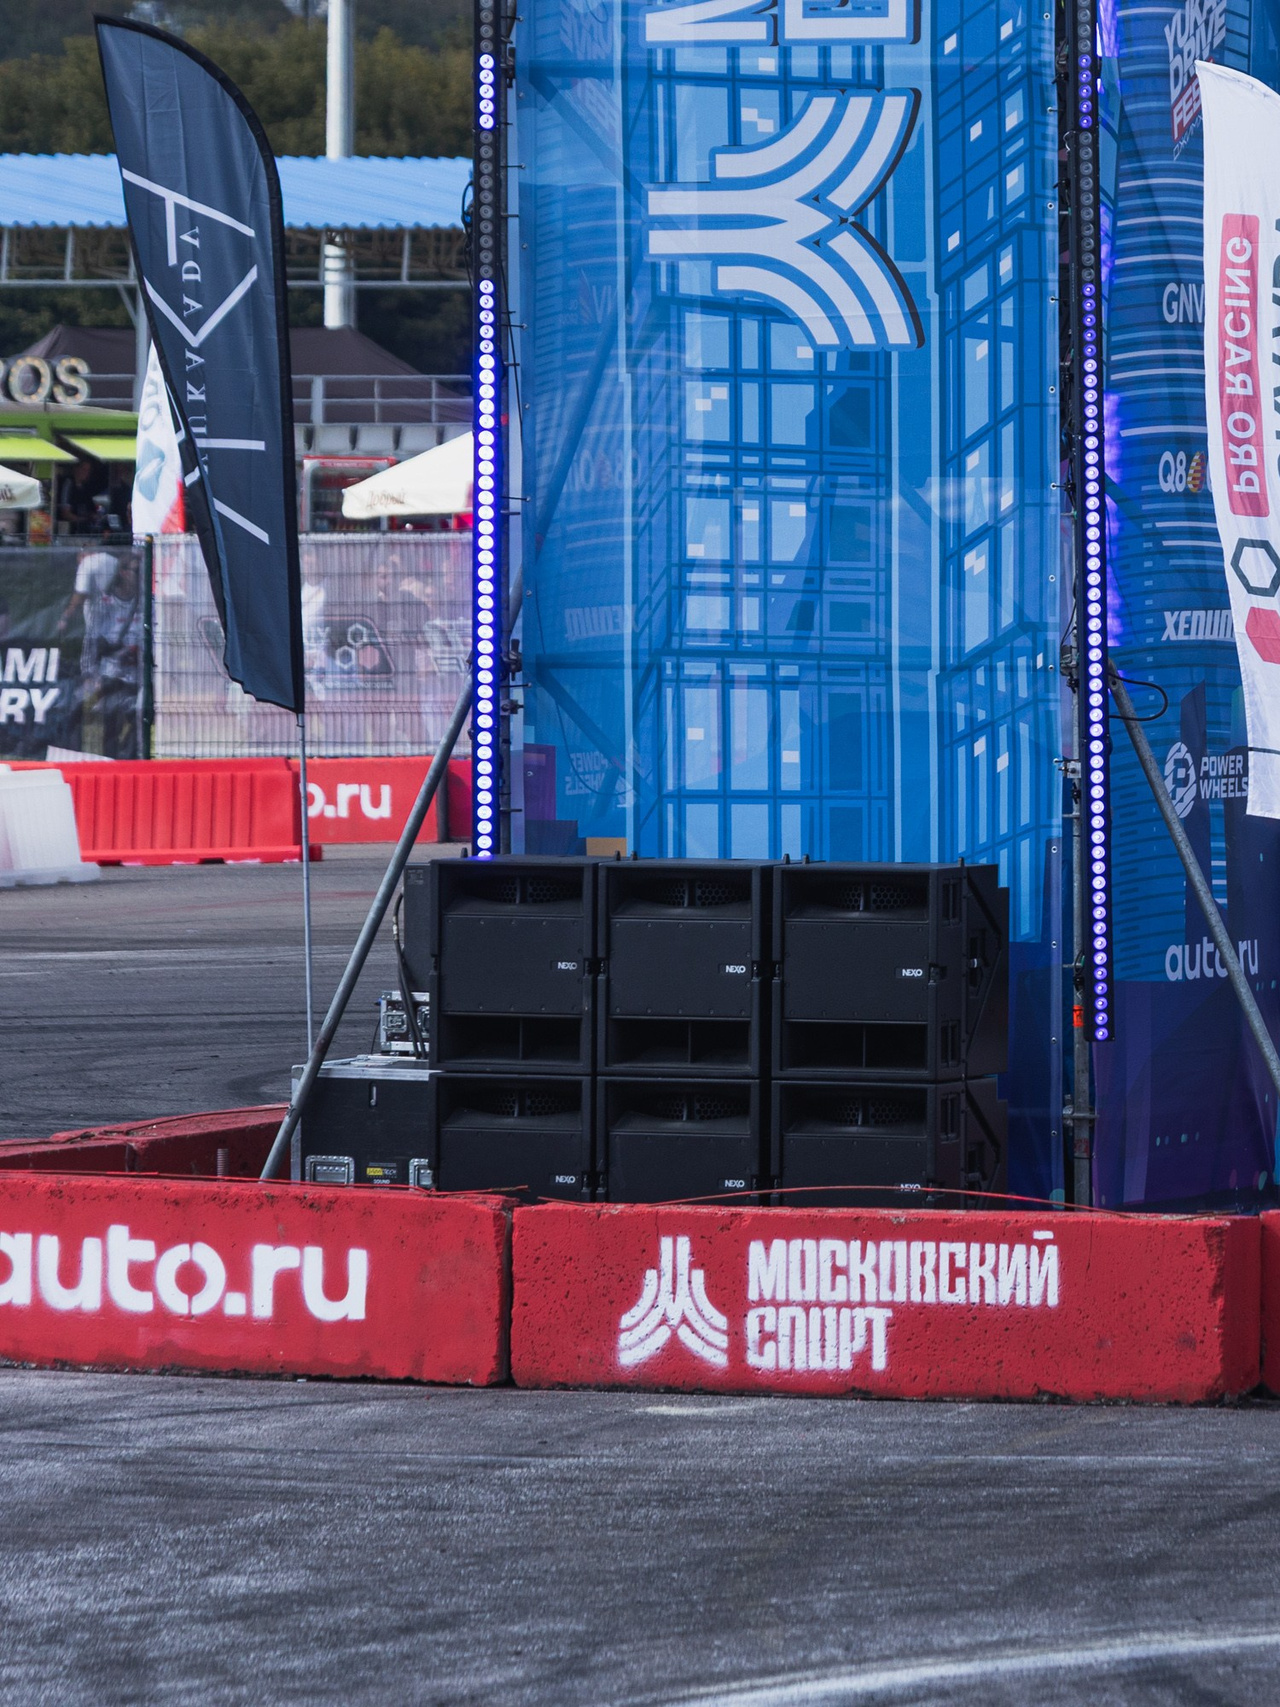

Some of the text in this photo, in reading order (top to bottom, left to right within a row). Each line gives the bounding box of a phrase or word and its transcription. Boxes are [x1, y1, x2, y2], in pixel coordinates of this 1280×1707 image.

[0, 356, 89, 403] OS
[1158, 450, 1187, 493] Q8
[1199, 755, 1244, 776] POWER
[1198, 777, 1249, 800] WHEELS
[558, 961, 577, 970] NEXO
[726, 965, 746, 974] NEXO
[902, 968, 923, 977] NEXO
[555, 1175, 576, 1184] NEXO
[725, 1179, 746, 1188] NEXO
[745, 1230, 1060, 1307] МОСКОВСКИЙ
[745, 1306, 893, 1371] СПОРТ
